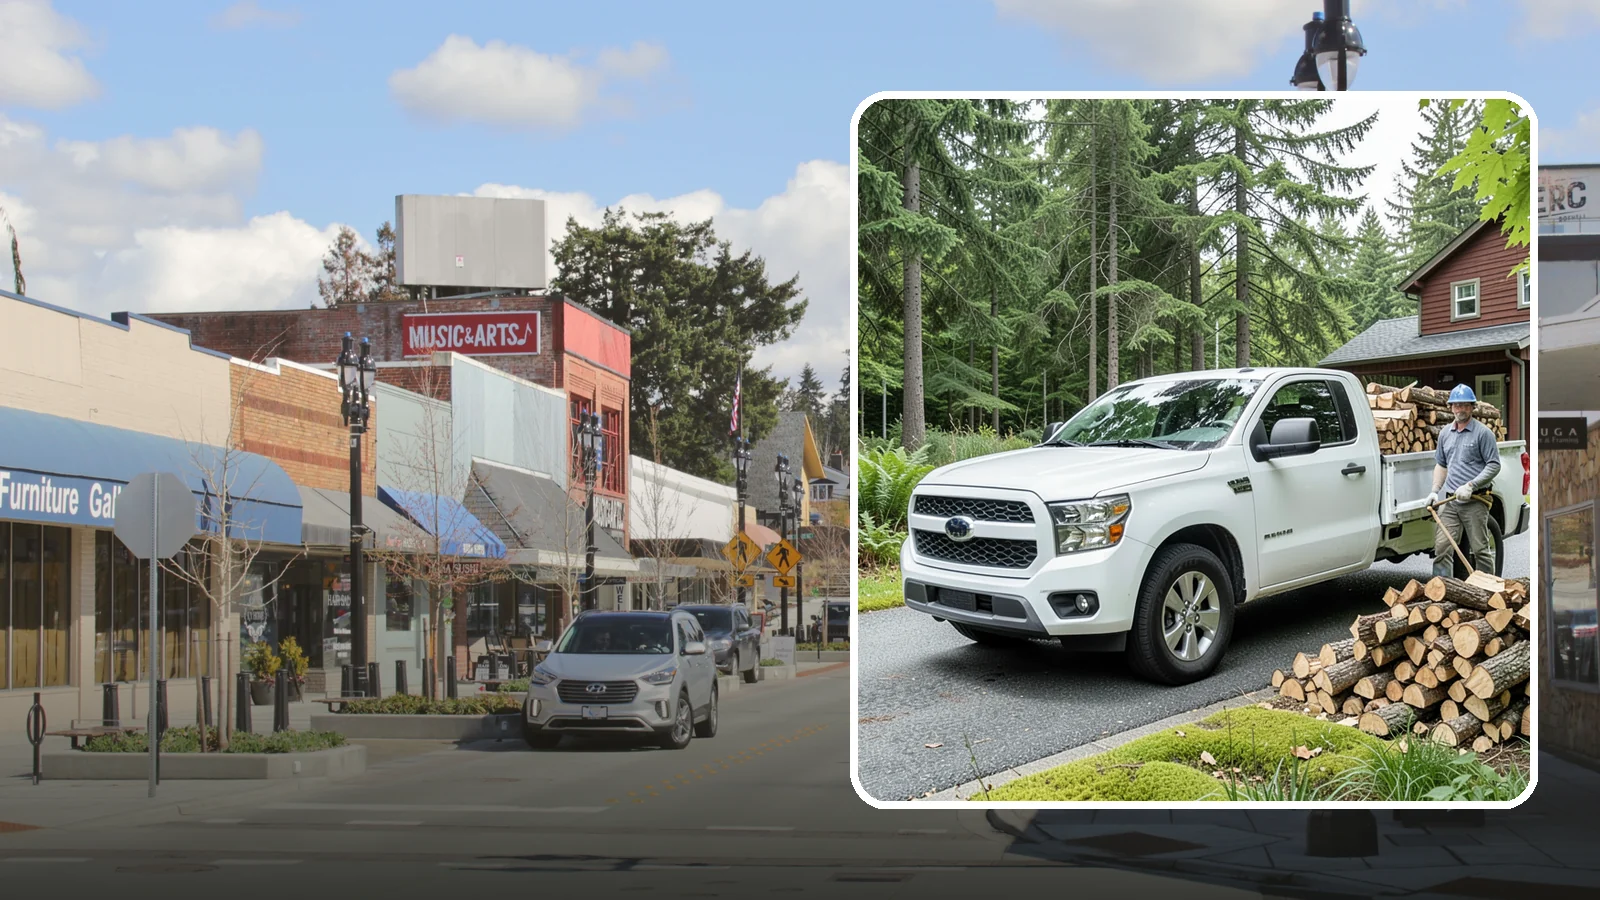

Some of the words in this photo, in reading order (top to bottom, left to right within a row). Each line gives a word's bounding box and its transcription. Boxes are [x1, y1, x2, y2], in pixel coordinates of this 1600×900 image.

[1540, 427, 1577, 436] UGA
[0, 471, 79, 515] Furniture
[89, 482, 121, 519] Gal
[454, 563, 479, 574] SUSHI
